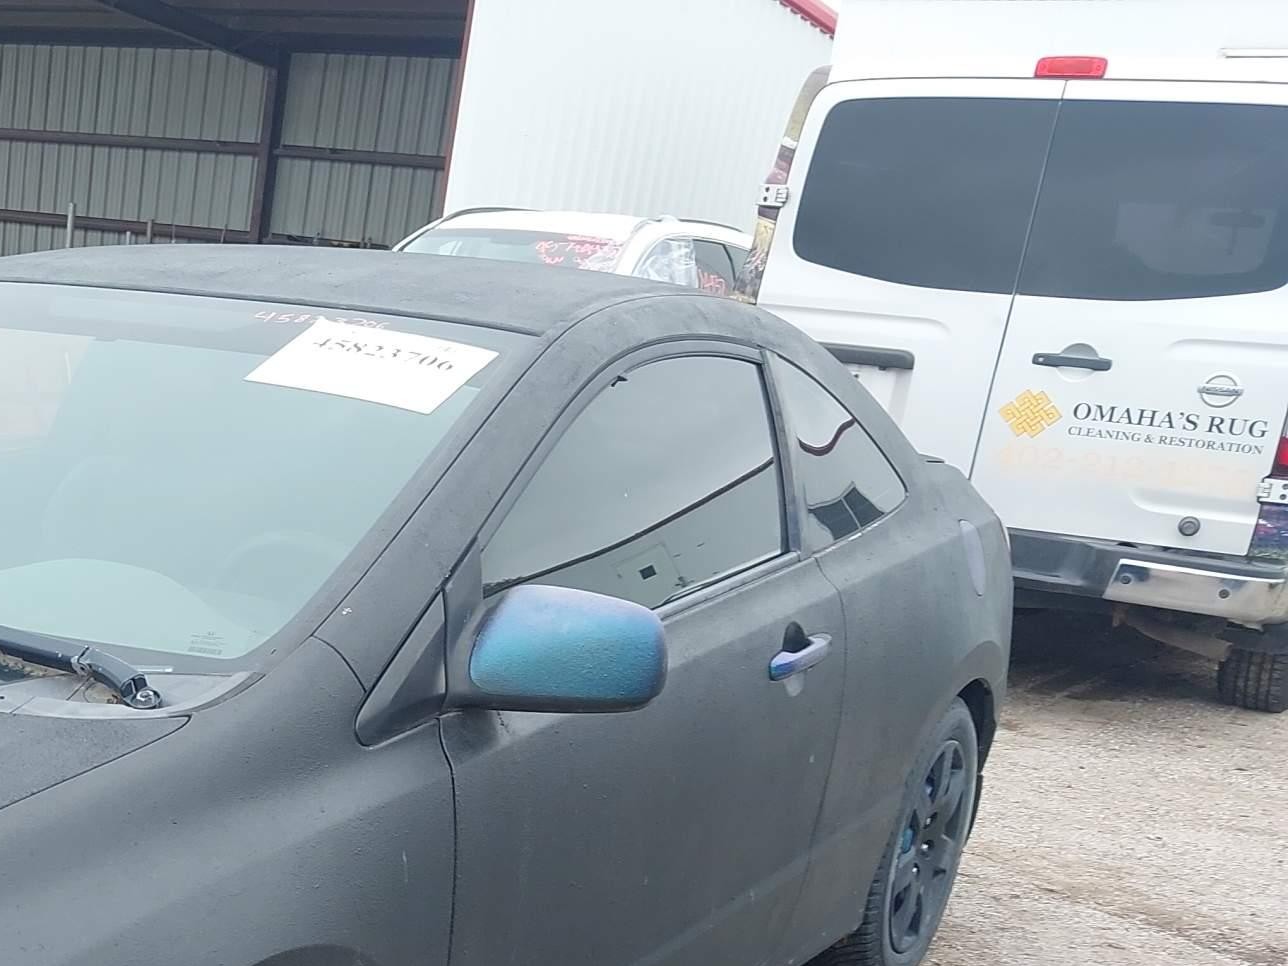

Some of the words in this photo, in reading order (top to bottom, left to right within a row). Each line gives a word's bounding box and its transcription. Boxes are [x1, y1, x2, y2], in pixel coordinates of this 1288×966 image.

[312, 337, 455, 373] 45823706
[1073, 402, 1201, 432] OMAHA'S
[1206, 415, 1270, 439] RUG
[1067, 425, 1142, 443] CLEANING
[1143, 433, 1155, 444] &
[1157, 434, 1265, 456] RESTORATION
